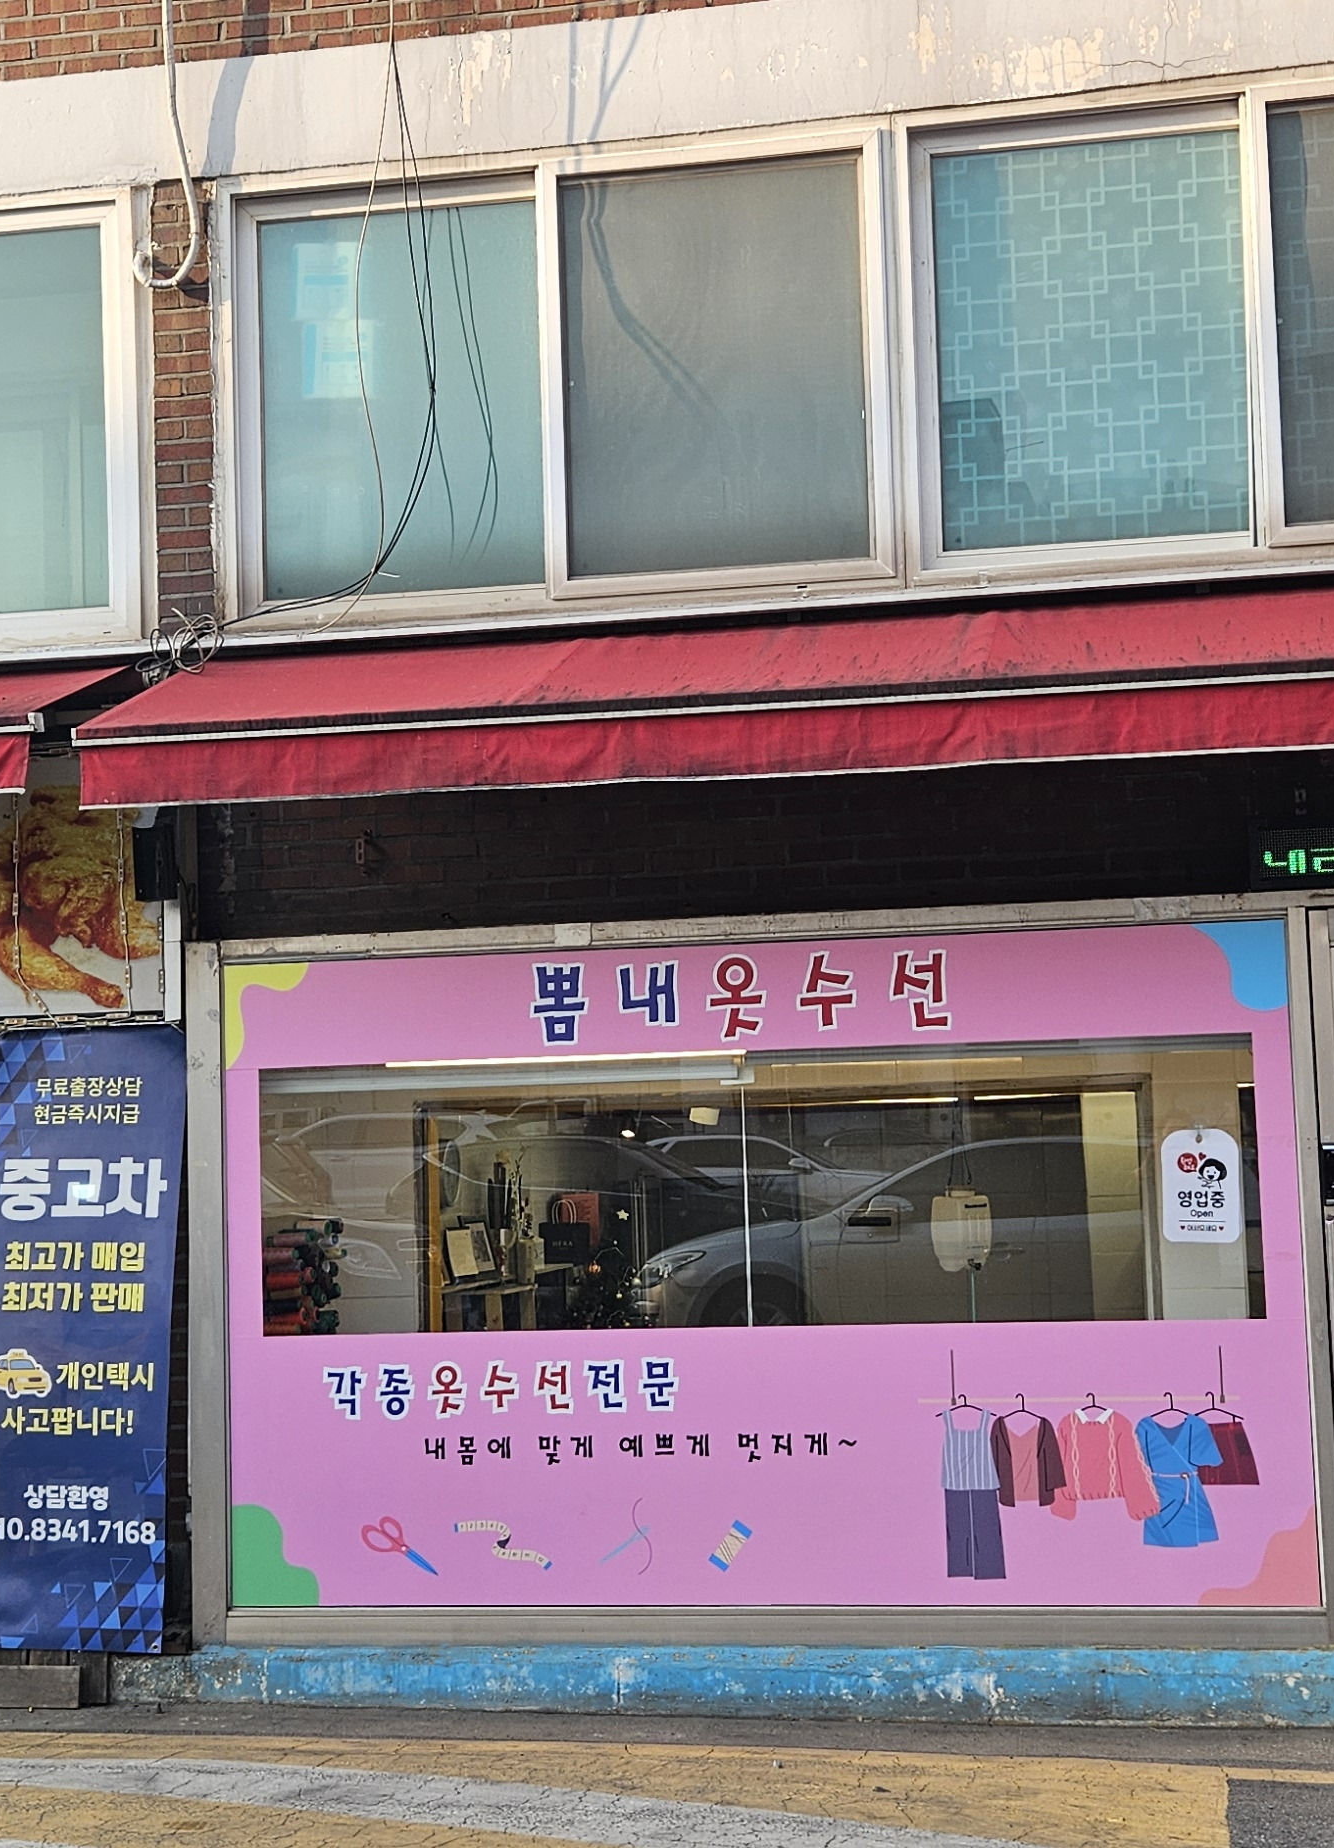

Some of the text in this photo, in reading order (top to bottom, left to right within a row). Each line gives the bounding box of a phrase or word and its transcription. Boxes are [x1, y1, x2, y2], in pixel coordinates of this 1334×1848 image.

[35, 1077, 143, 1098] 무료출장상담
[34, 1103, 140, 1125] 현금즉시지급
[0, 1157, 167, 1221] 중고차
[1178, 1190, 1225, 1208] 영업중
[1190, 1209, 1213, 1218] Open
[4, 1241, 146, 1272] 최고가 매입
[1, 1281, 145, 1313] 최저가 판매
[55, 1361, 154, 1392] 개인택시
[1, 1406, 134, 1437] 사고팝니다!
[424, 1435, 512, 1466] 내몸에
[538, 1434, 594, 1465] 맞게
[618, 1432, 711, 1458] 예쁘게
[24, 1484, 109, 1511] 상담환영
